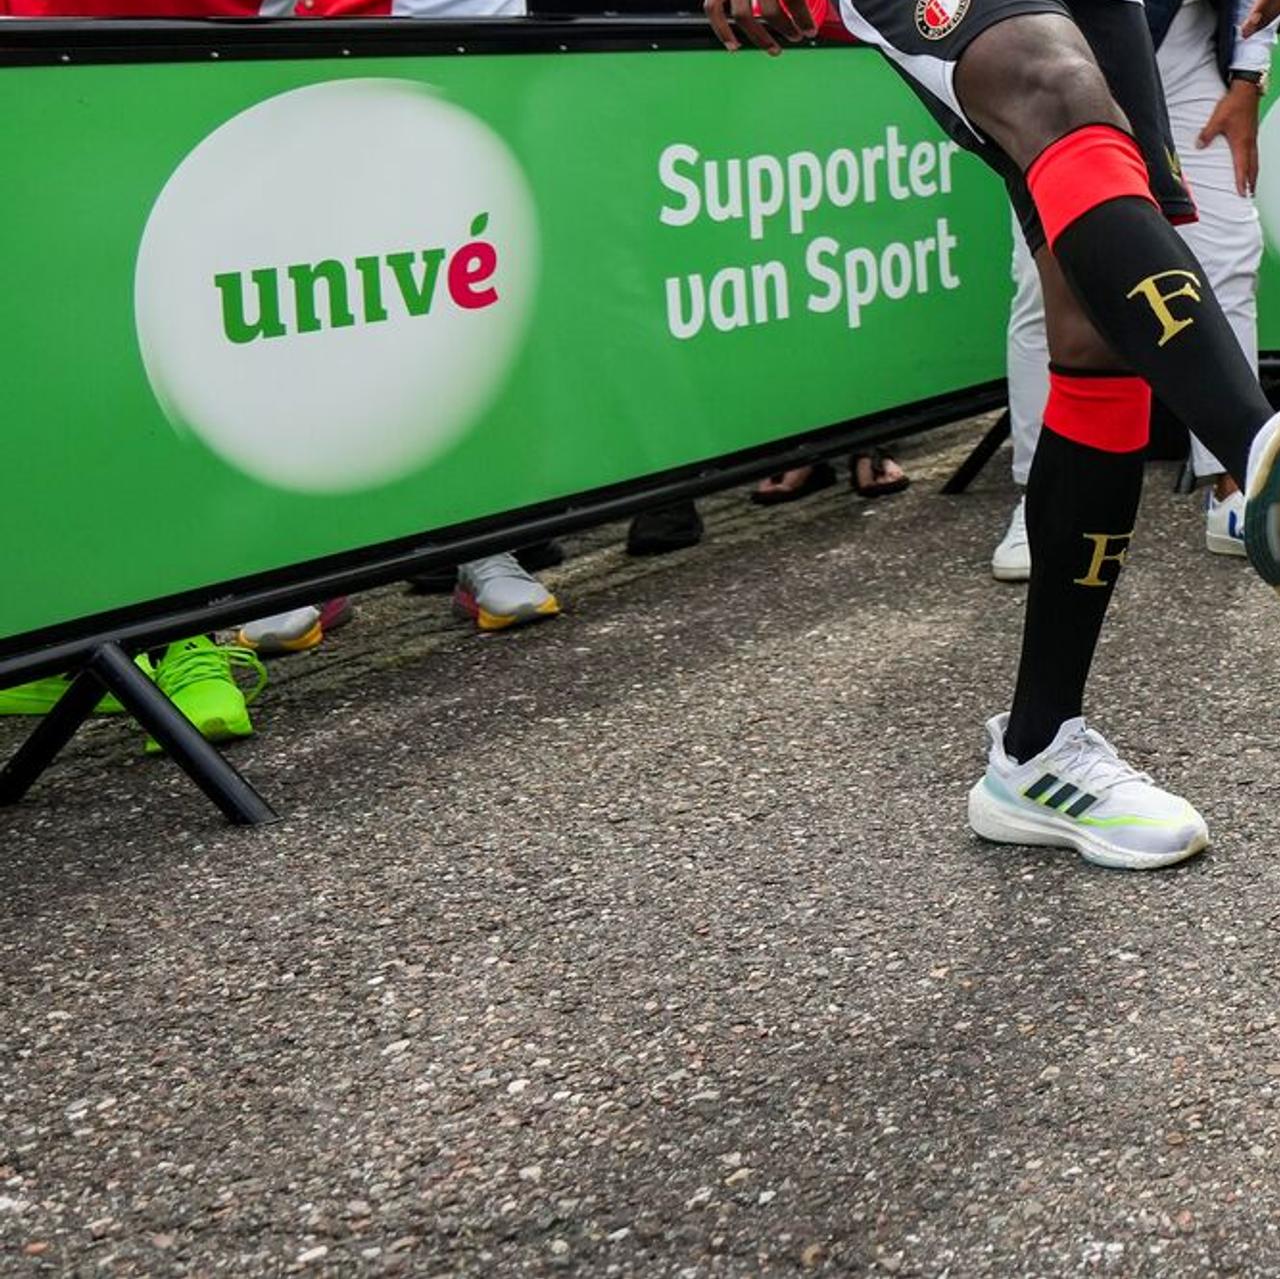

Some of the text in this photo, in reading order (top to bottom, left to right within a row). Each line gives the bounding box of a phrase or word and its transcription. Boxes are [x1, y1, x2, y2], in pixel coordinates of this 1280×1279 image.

[657, 125, 960, 241] Supporter
[214, 212, 500, 345] univé
[665, 217, 961, 340] van Sport
[1126, 269, 1202, 348] F
